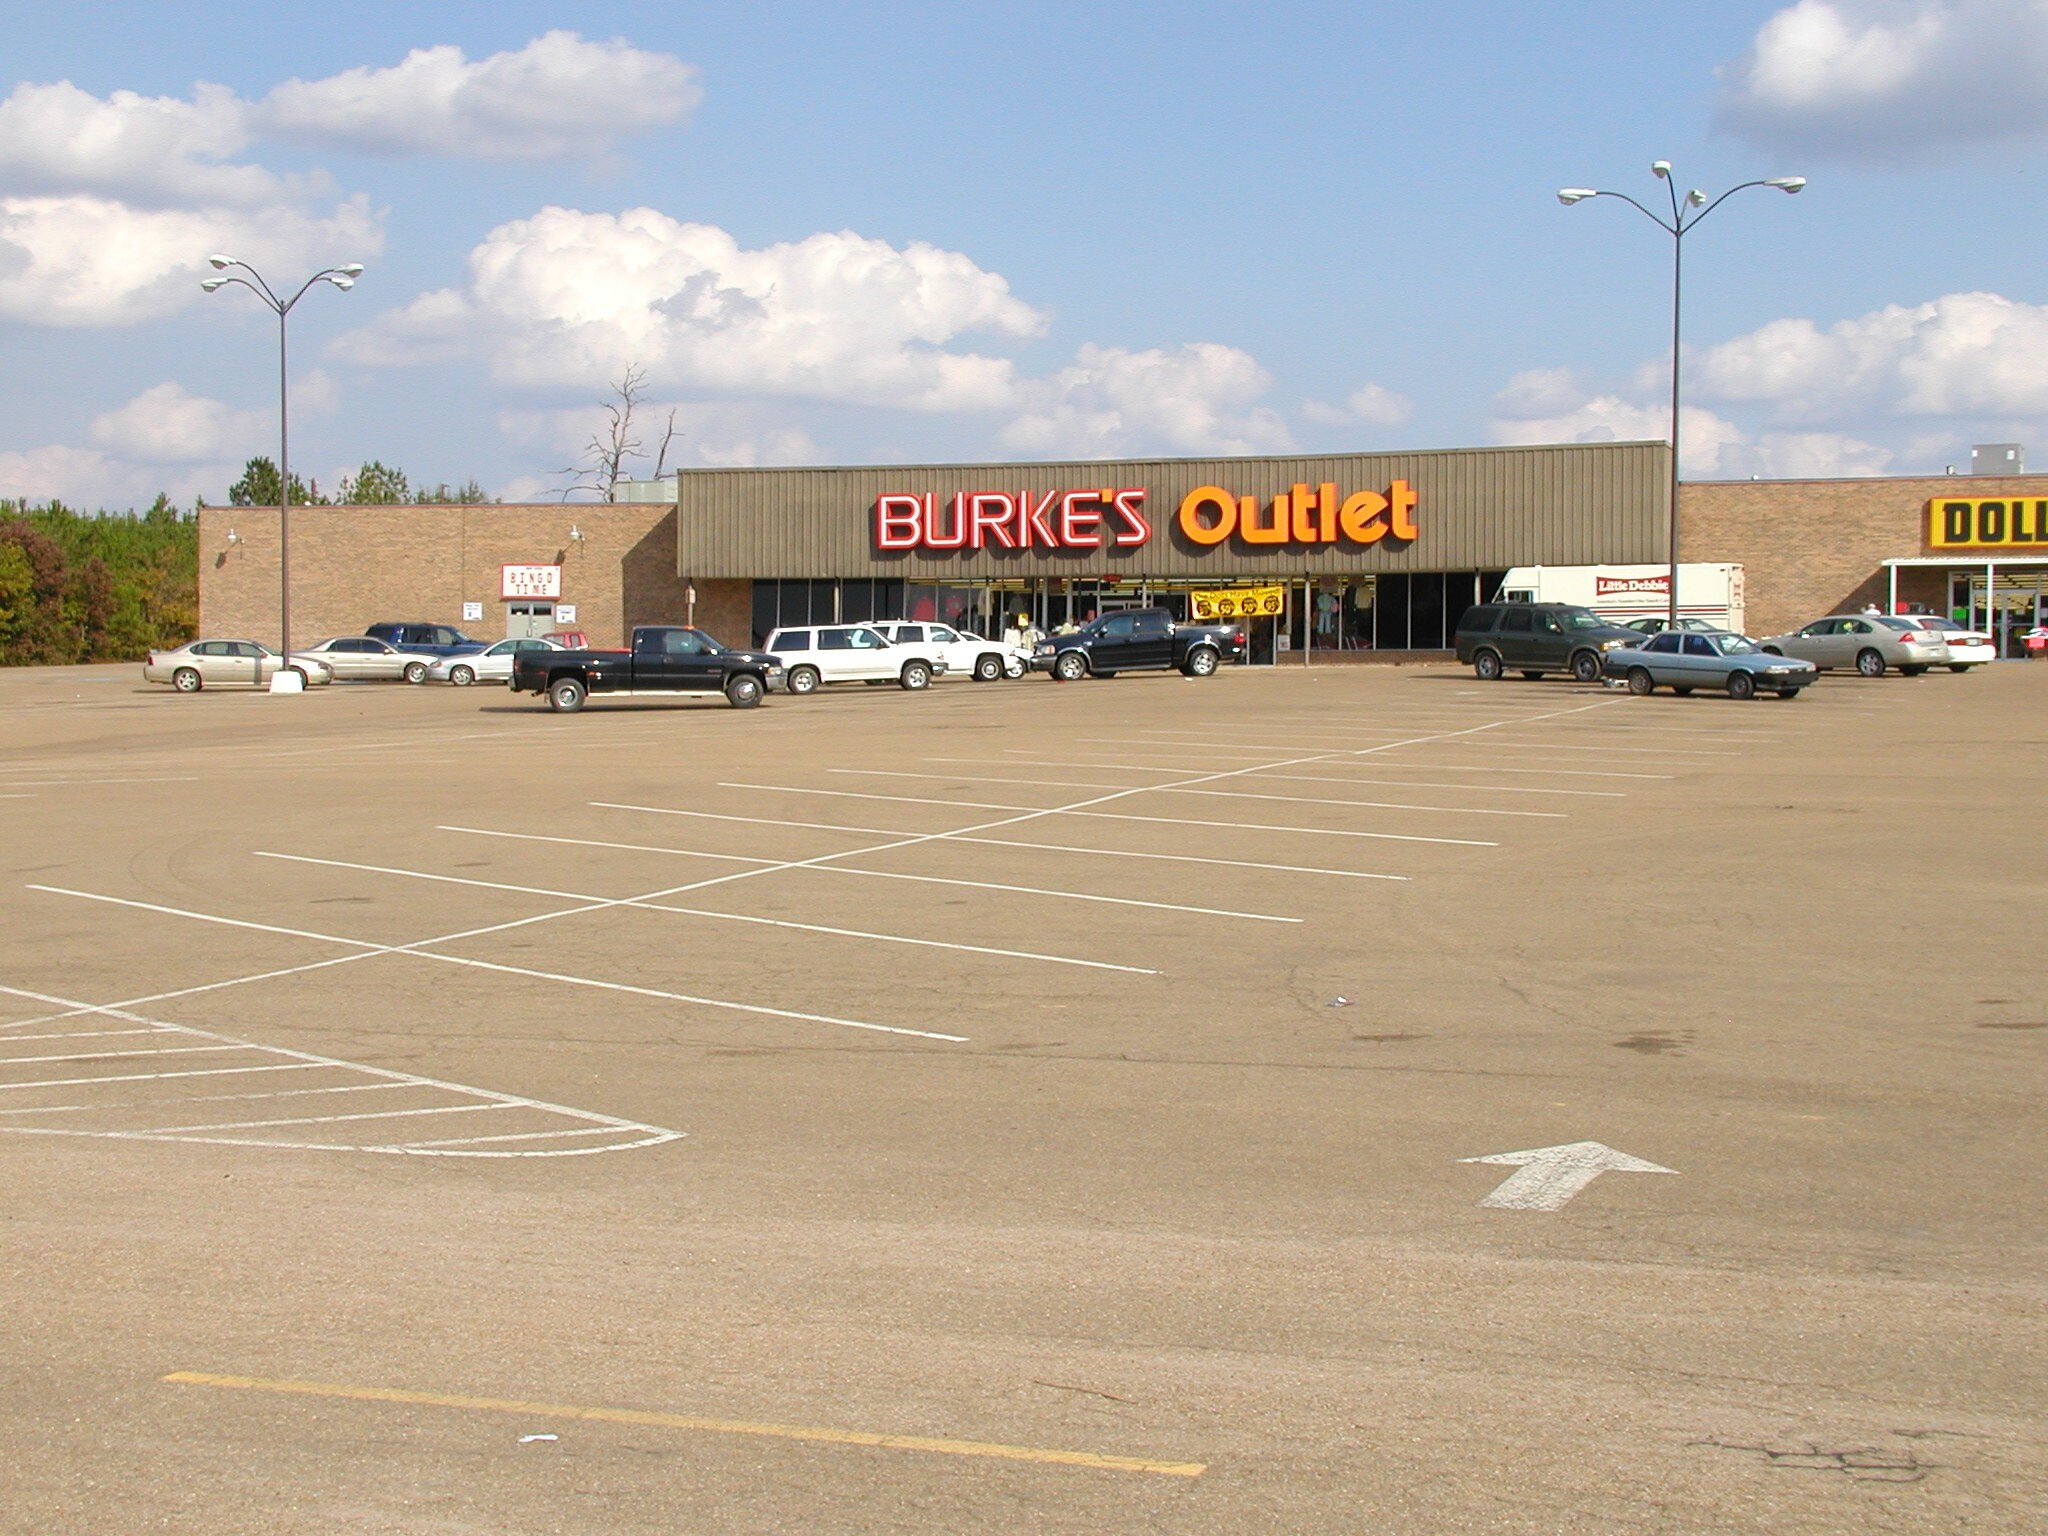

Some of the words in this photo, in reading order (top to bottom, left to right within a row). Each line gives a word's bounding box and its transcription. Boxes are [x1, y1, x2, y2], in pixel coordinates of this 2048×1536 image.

[875, 487, 1151, 549] BURKE'S
[1178, 479, 1418, 544] Outlet
[510, 572, 552, 583] BINGO
[515, 584, 547, 595] TIME
[1599, 581, 1628, 591] Little
[1628, 579, 1668, 591] Debbie
